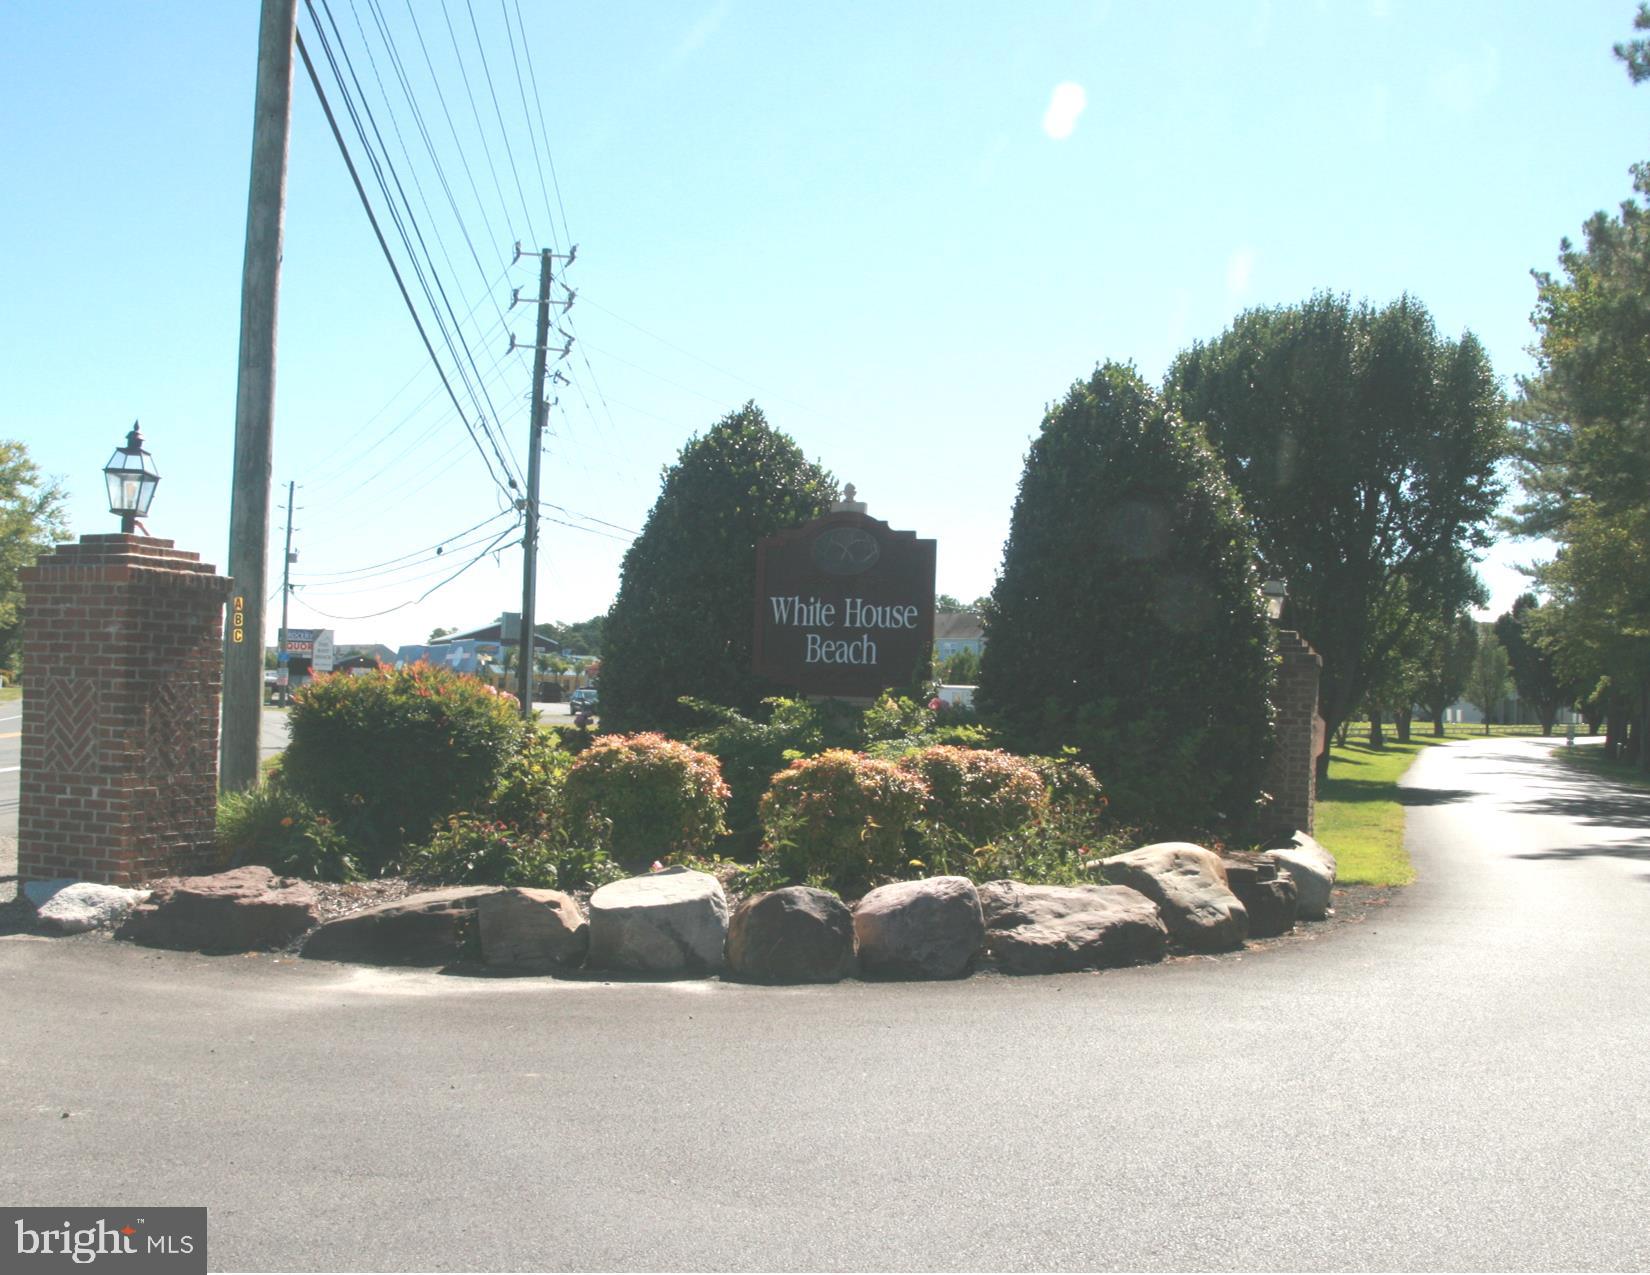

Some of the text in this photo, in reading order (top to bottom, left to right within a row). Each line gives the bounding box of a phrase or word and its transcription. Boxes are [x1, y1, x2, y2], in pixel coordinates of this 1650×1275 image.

[770, 596, 918, 629] White House
[805, 633, 877, 664] Beach
